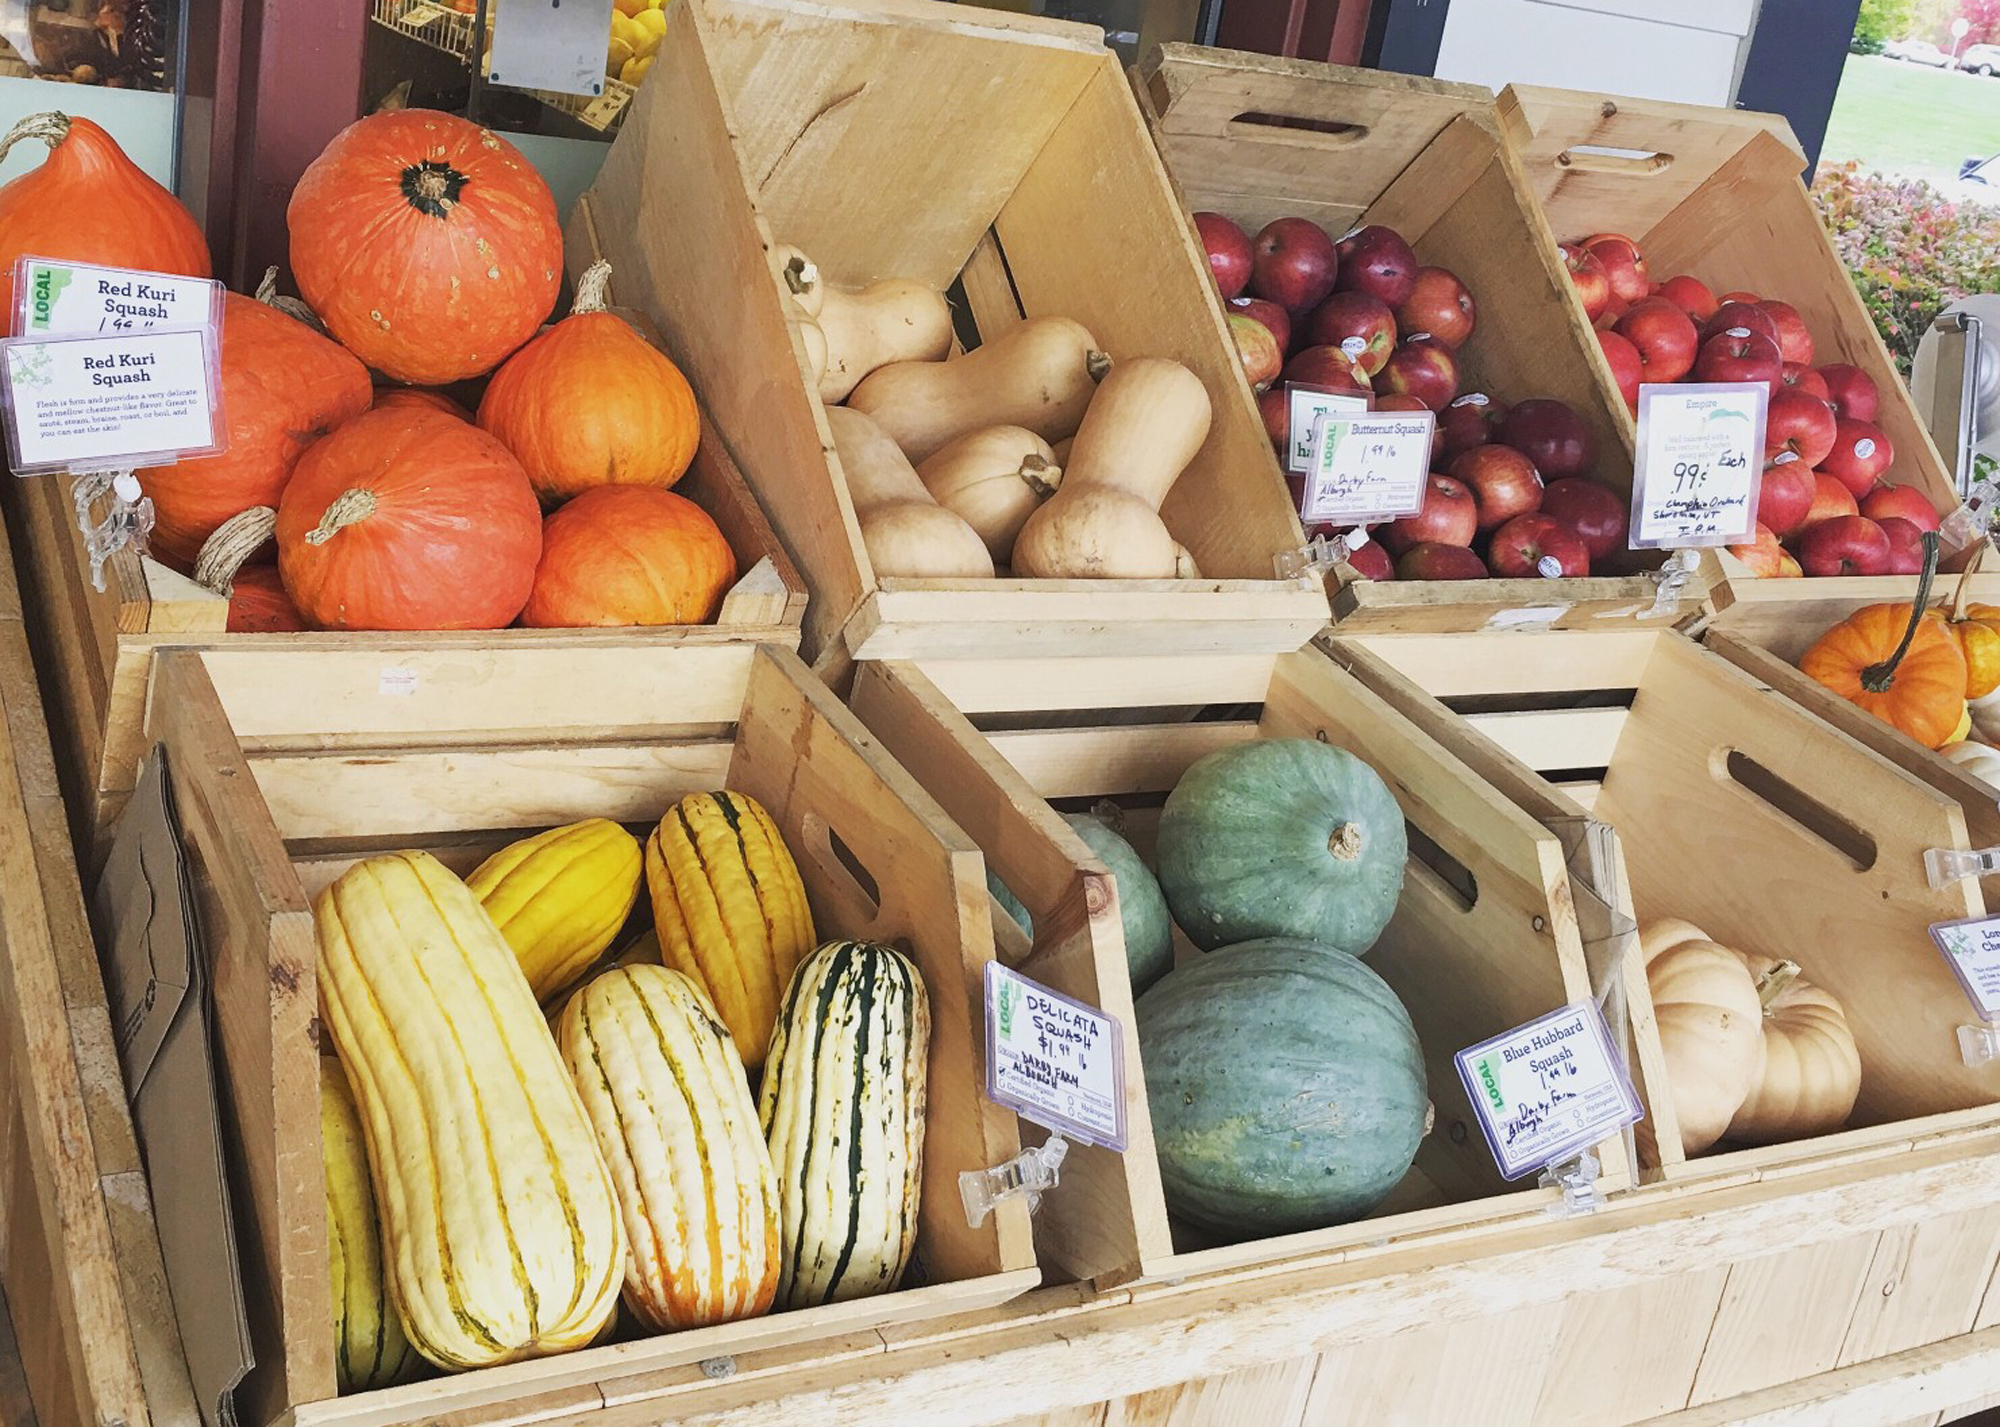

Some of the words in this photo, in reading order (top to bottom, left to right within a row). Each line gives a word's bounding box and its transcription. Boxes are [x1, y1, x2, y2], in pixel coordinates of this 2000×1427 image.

[35, 271, 51, 322] LOCAL
[98, 280, 132, 297] Red
[137, 285, 176, 302] Kuri
[104, 299, 168, 318] Squash
[84, 355, 115, 370] Red
[118, 353, 156, 366] Kuri
[92, 369, 151, 387] Squash
[36, 400, 58, 408] Flesh
[88, 396, 102, 405] and
[104, 394, 139, 404] provides
[166, 389, 198, 397] delicate
[1686, 400, 1717, 410] Empire
[38, 408, 53, 418] and
[55, 408, 84, 417] mellow
[165, 400, 186, 408] Great
[172, 408, 188, 416] and
[40, 430, 55, 438] you
[73, 427, 86, 435] eat
[87, 426, 101, 434] the
[1351, 424, 1394, 436] Butternut
[1394, 420, 1426, 436] Squash
[1324, 425, 1336, 467] LOCAL
[1718, 449, 1746, 469] Each
[1704, 511, 1721, 519] VT
[1000, 981, 1010, 1034] LOCAL
[1026, 996, 1098, 1037] DELICATA
[1032, 1016, 1092, 1050] SQUASH
[1502, 1046, 1531, 1062] Blue
[1531, 1018, 1584, 1051] Hubbard
[1530, 1046, 1574, 1073] Squash
[1021, 1051, 1052, 1077] DARBY
[1054, 1067, 1078, 1088] FARM
[1478, 1060, 1504, 1108] LOCAL
[1550, 1089, 1577, 1106] Farm
